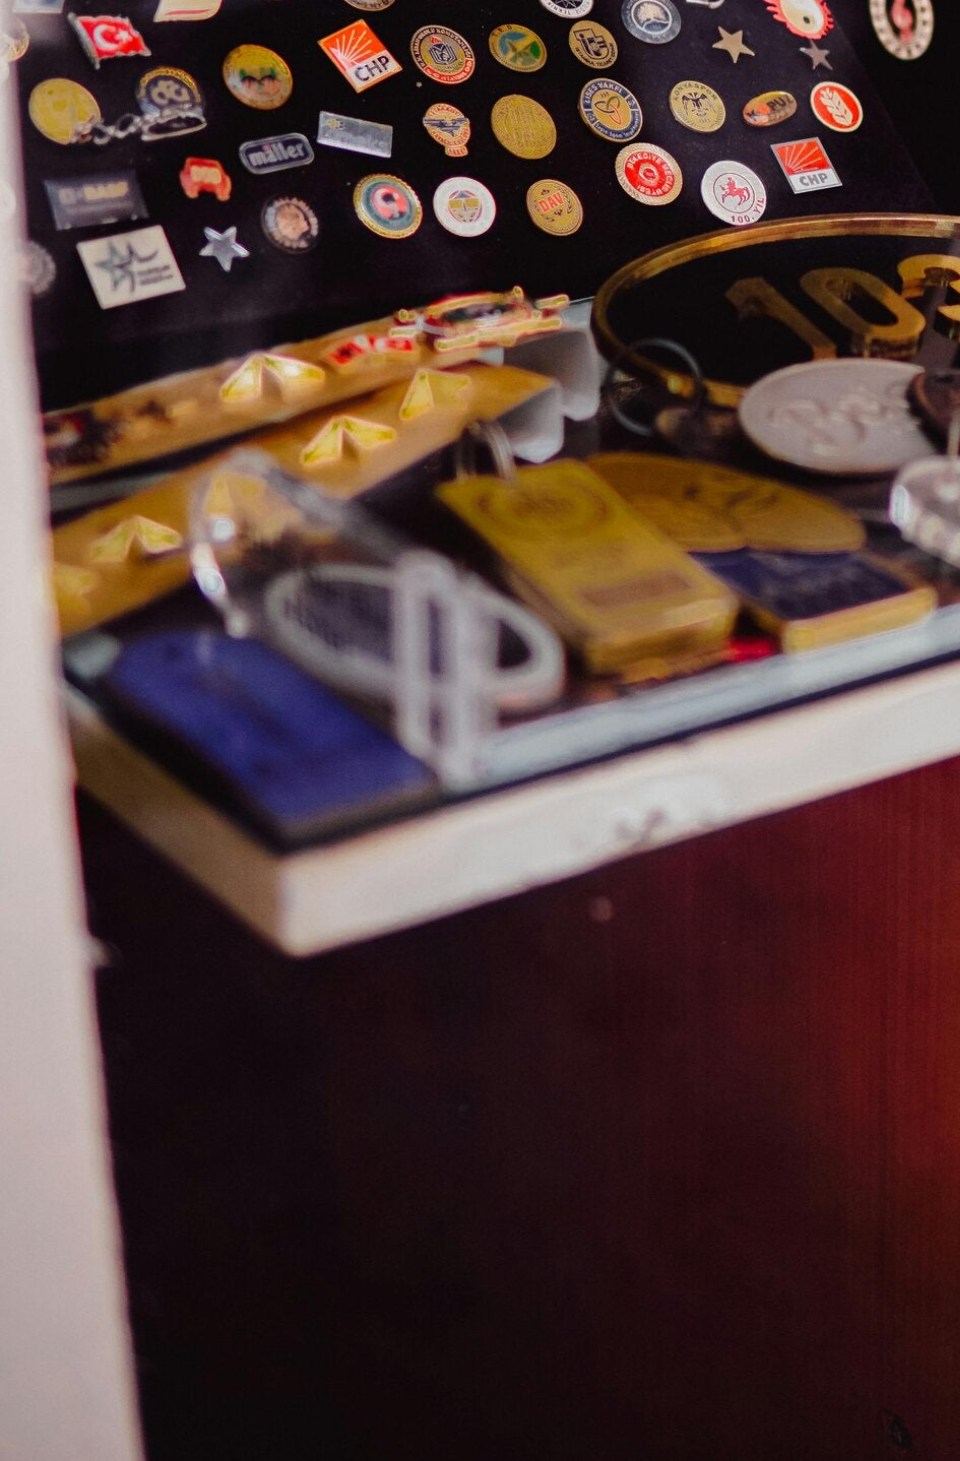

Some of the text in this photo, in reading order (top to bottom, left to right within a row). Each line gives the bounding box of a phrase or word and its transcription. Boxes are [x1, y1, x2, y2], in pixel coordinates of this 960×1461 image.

[353, 55, 390, 81] CHP
[799, 173, 828, 186] CHP
[538, 191, 565, 213] DAV
[753, 197, 765, 215] YIL
